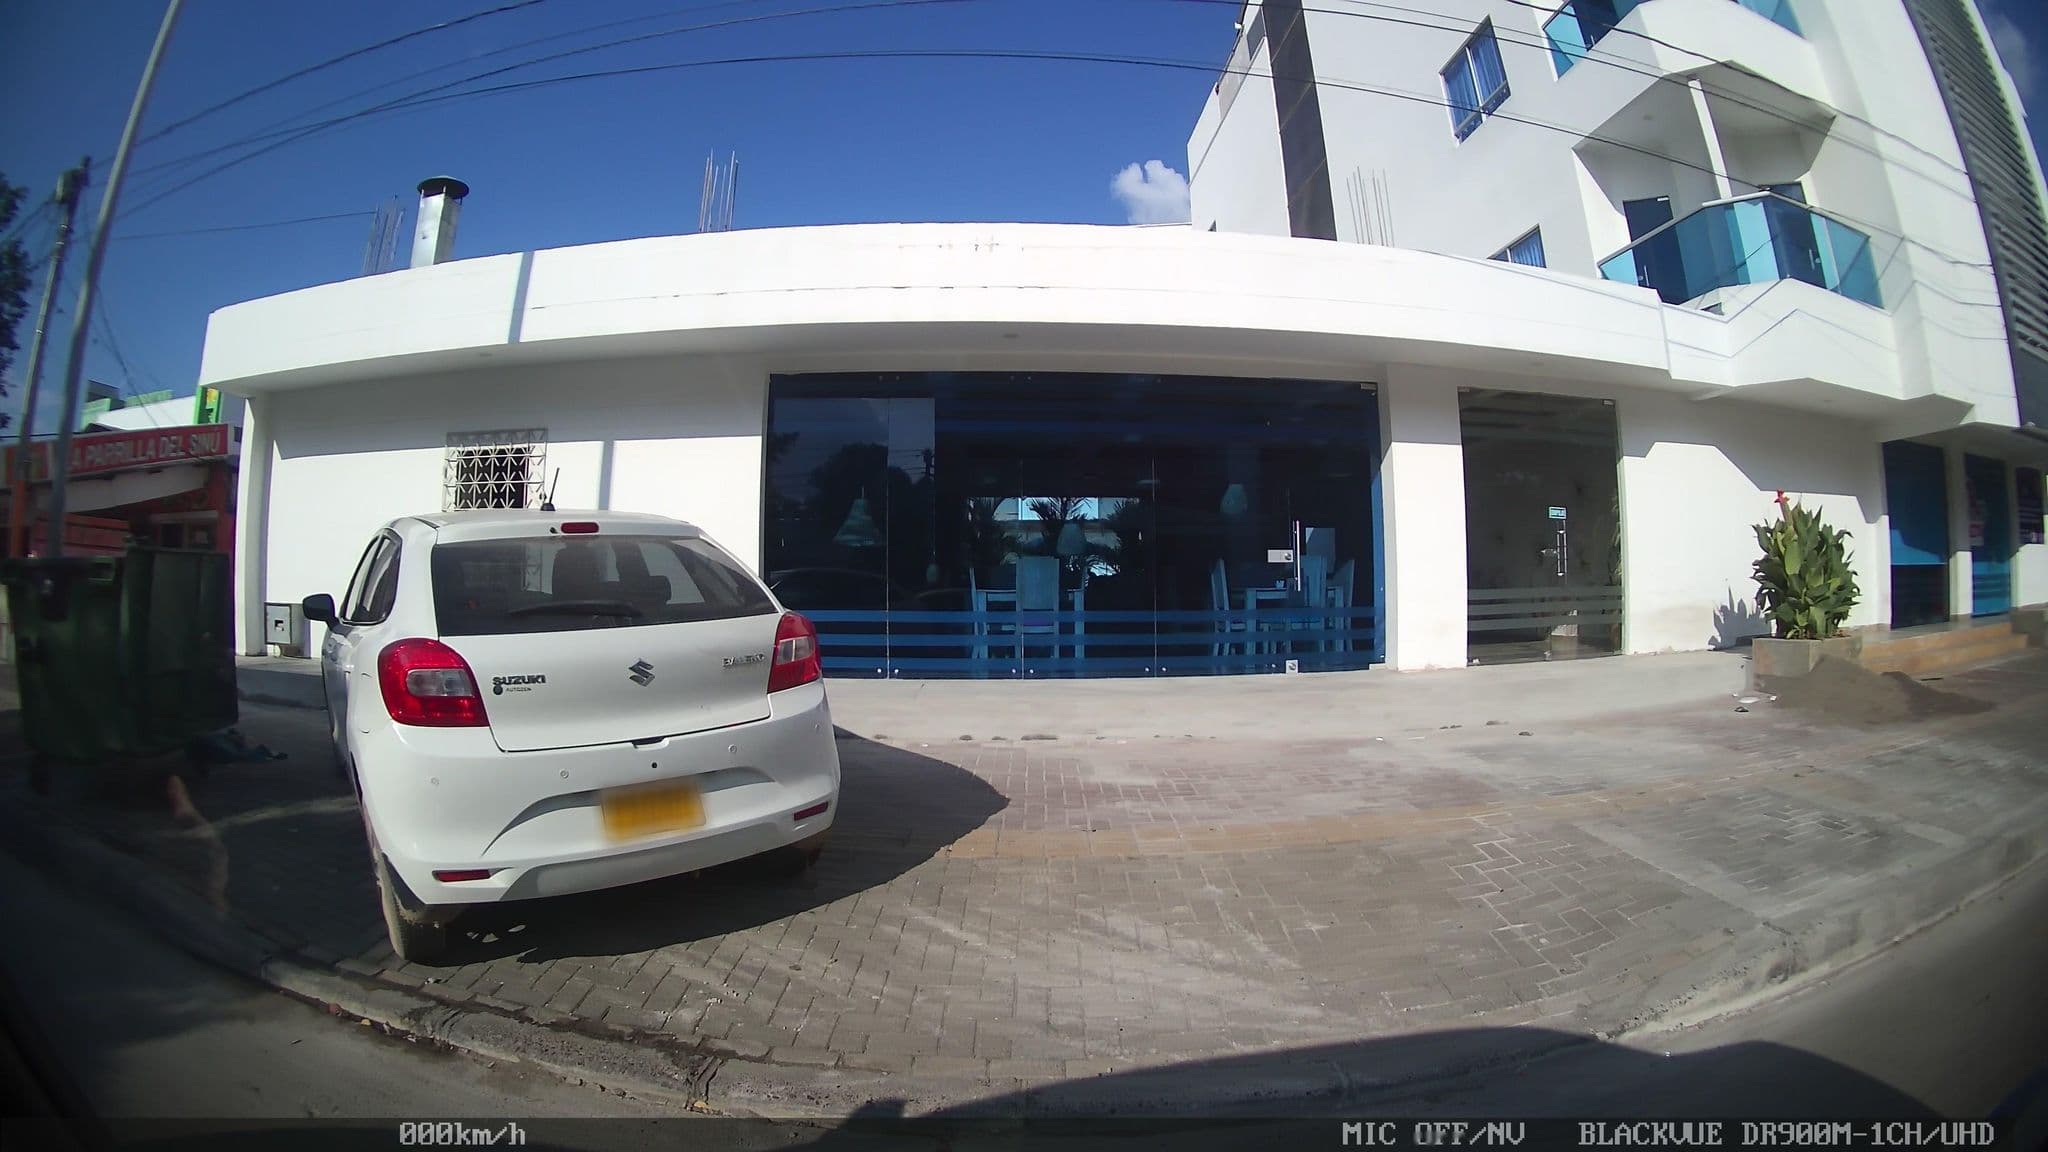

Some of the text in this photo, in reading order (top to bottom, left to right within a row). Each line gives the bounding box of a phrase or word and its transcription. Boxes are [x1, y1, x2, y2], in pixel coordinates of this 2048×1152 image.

[85, 438, 157, 468] PARRILLA
[159, 435, 185, 458] DEL
[492, 674, 546, 685] SUZUKI
